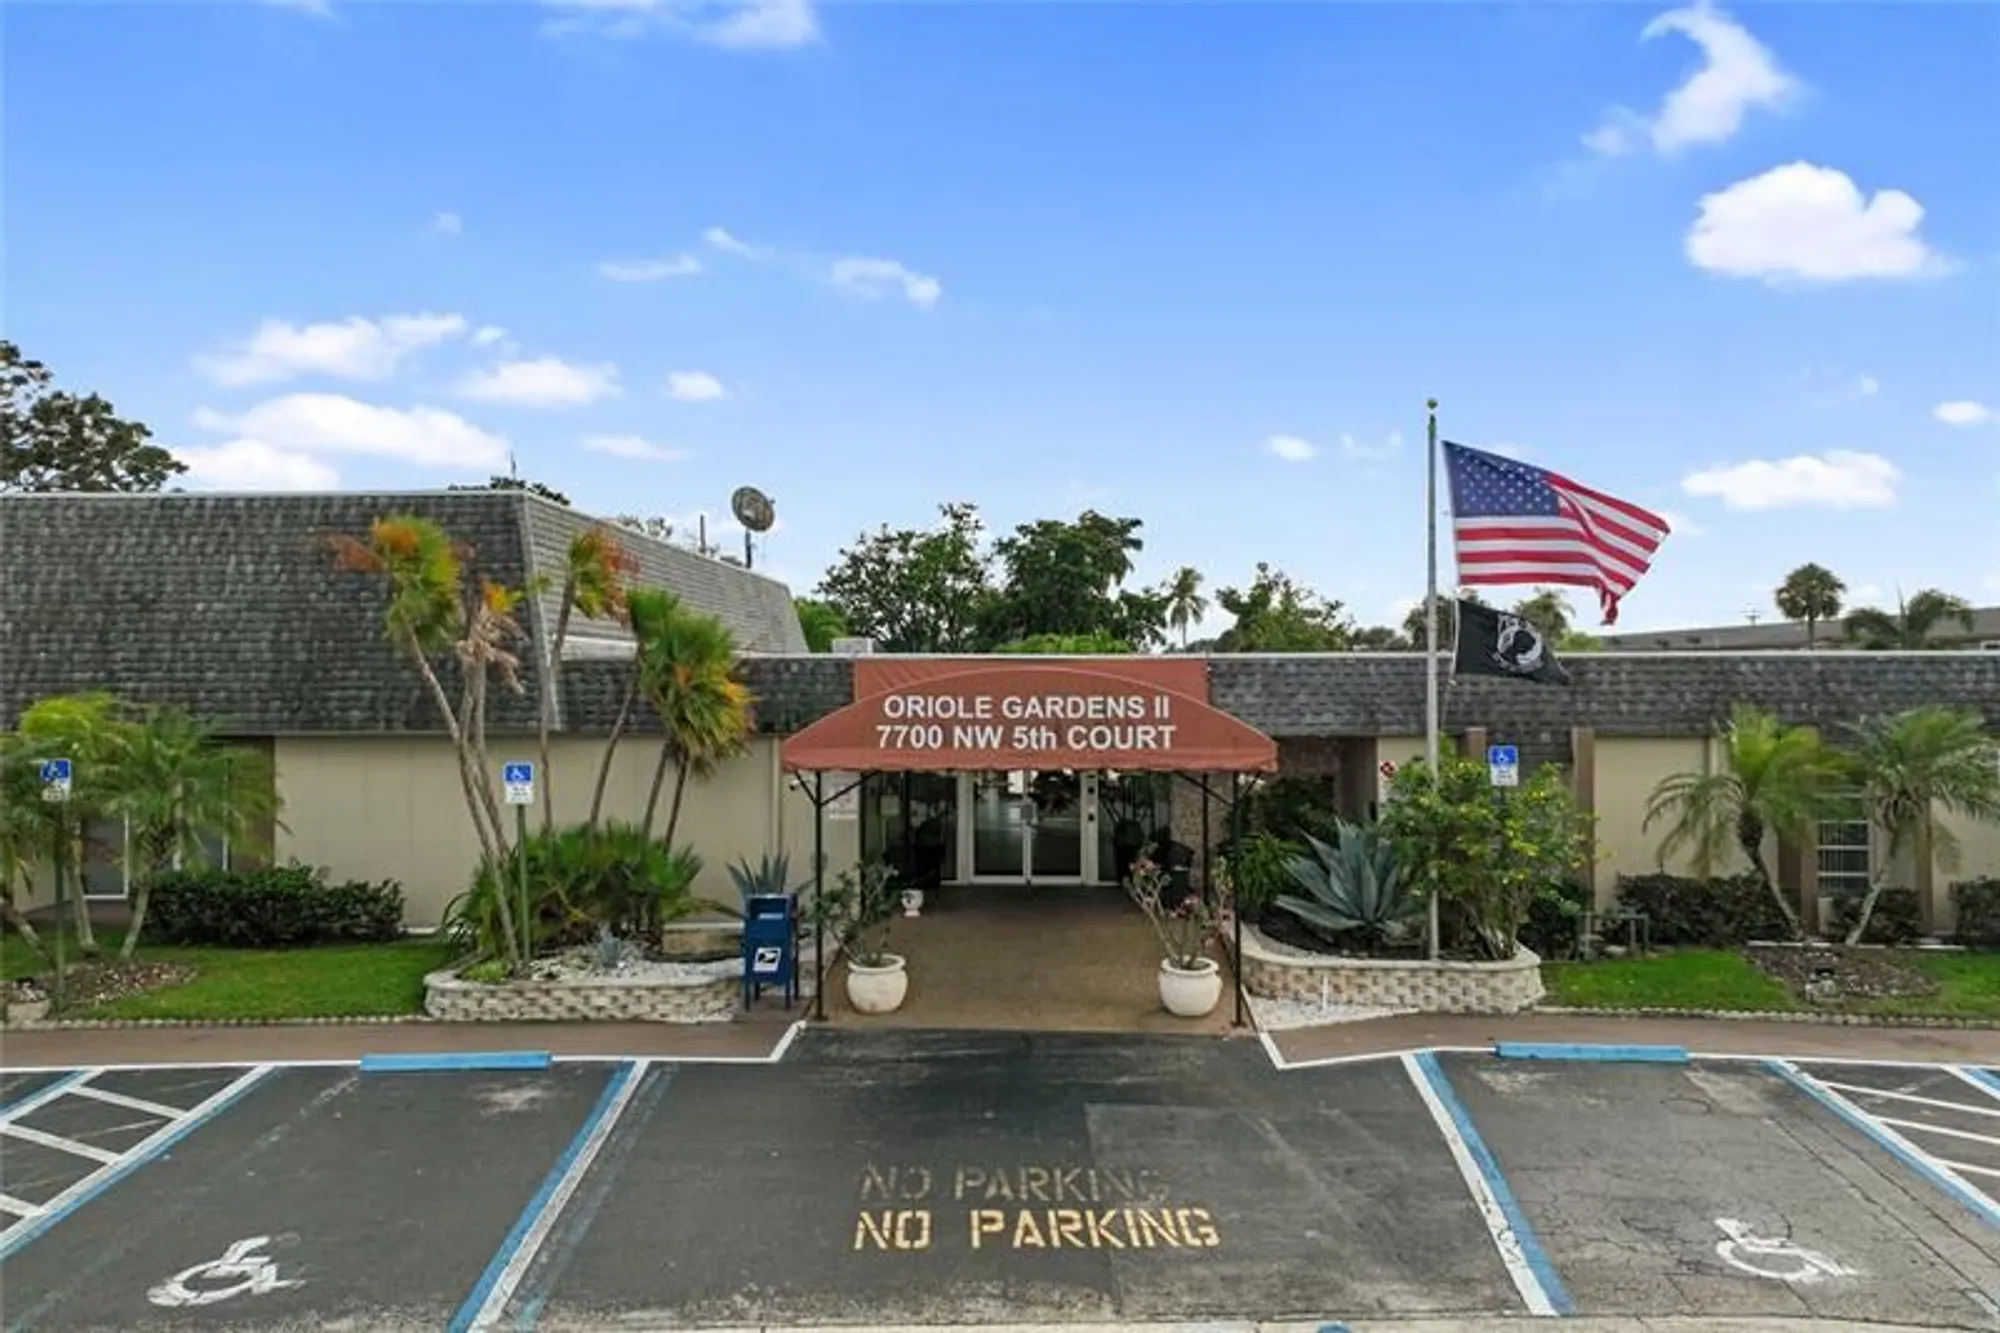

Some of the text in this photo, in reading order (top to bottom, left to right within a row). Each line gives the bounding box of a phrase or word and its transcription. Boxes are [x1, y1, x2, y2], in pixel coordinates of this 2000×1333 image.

[883, 695, 1170, 719] ORIOLE GARDENS II
[876, 725, 1177, 750] 7700 NW 5th COURT
[860, 1163, 1171, 1201] NO PARKING
[853, 1207, 1221, 1250] NO PARKING
